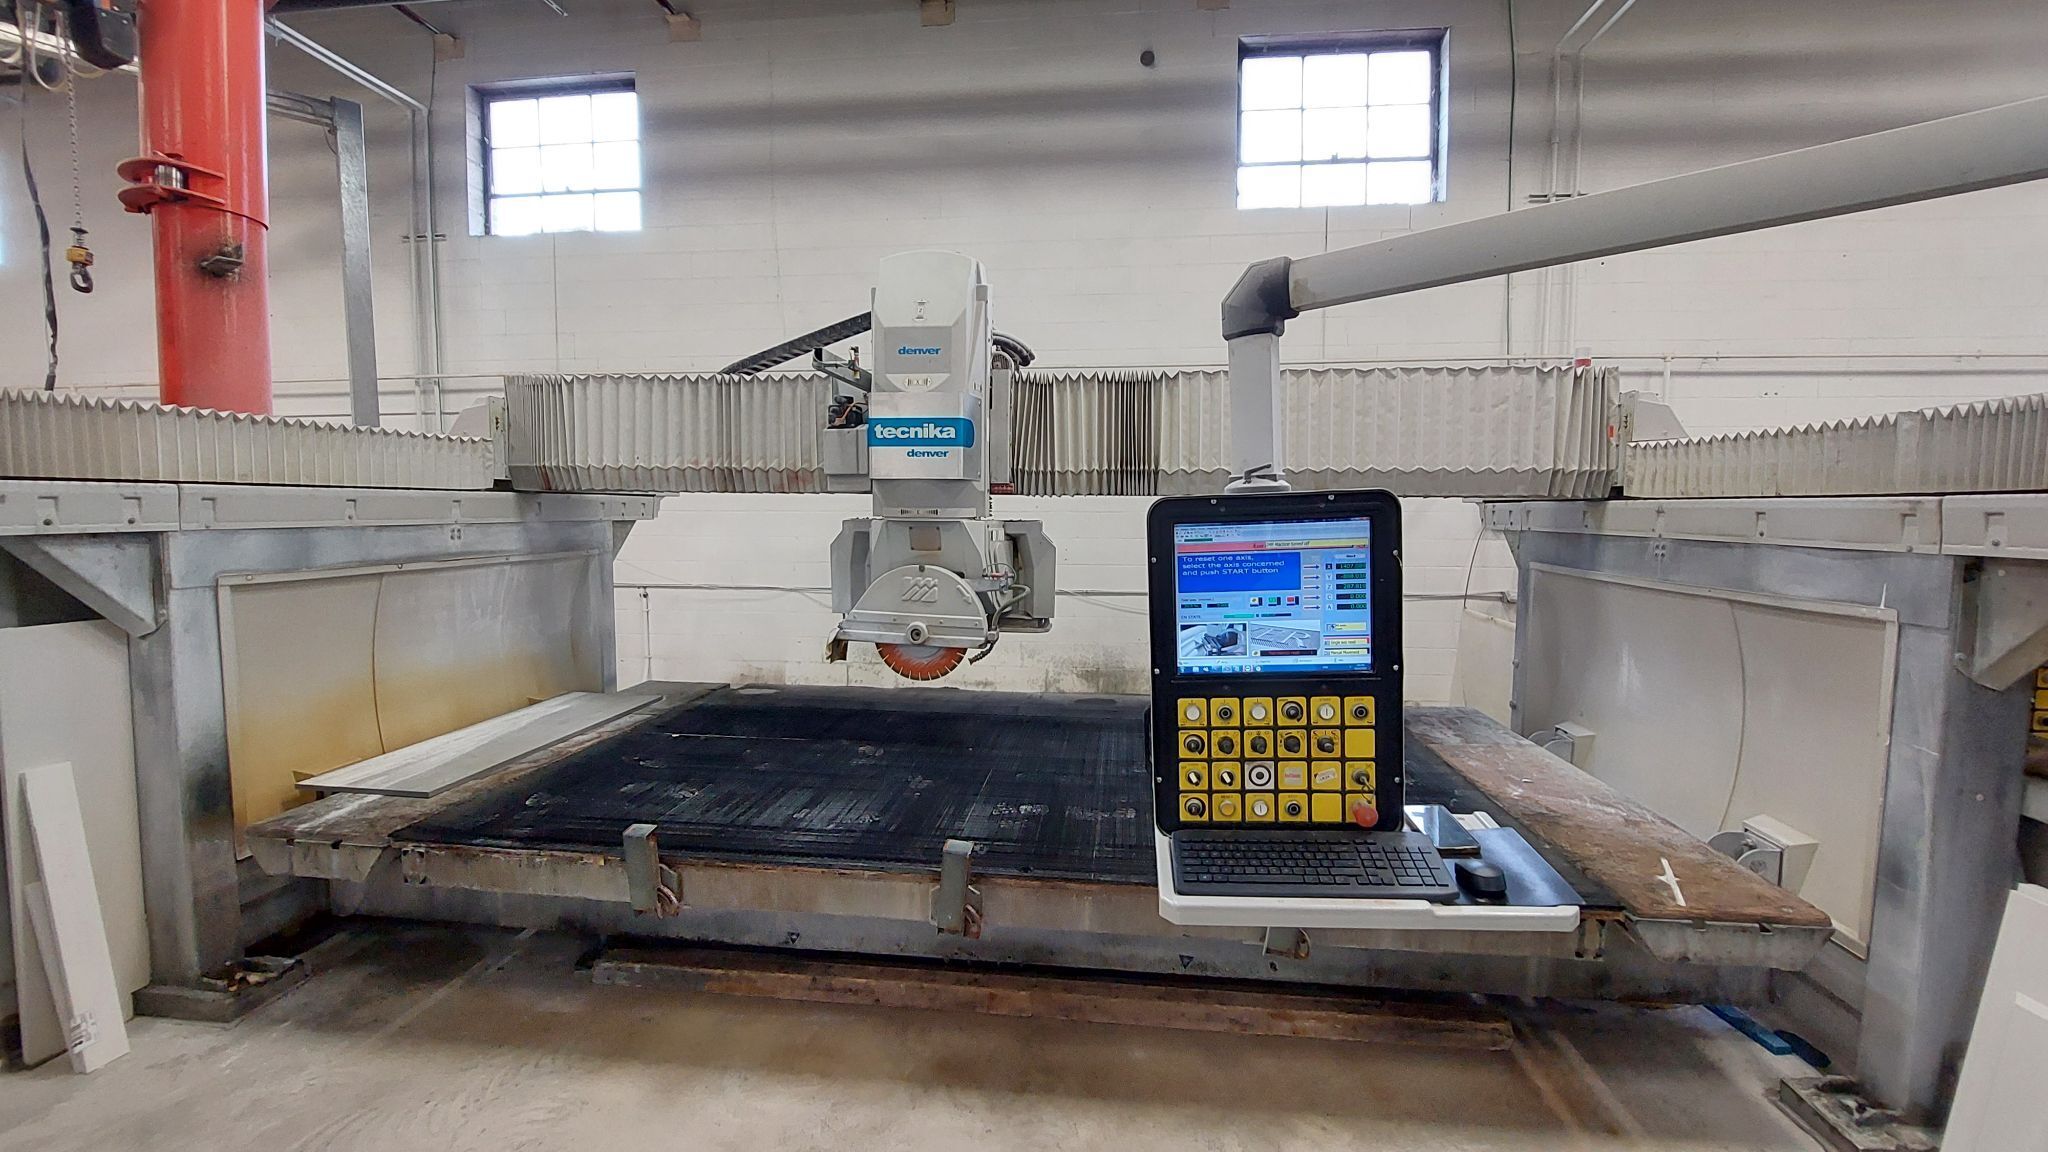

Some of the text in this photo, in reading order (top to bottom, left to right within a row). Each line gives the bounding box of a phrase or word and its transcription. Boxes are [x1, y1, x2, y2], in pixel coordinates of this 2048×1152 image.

[897, 346, 942, 355] denver
[873, 423, 956, 439] tecnika
[906, 449, 950, 458] denver
[1223, 560, 1240, 568] axis
[1242, 560, 1285, 568] concerned
[1182, 568, 1198, 576] and
[1200, 569, 1220, 577] push
